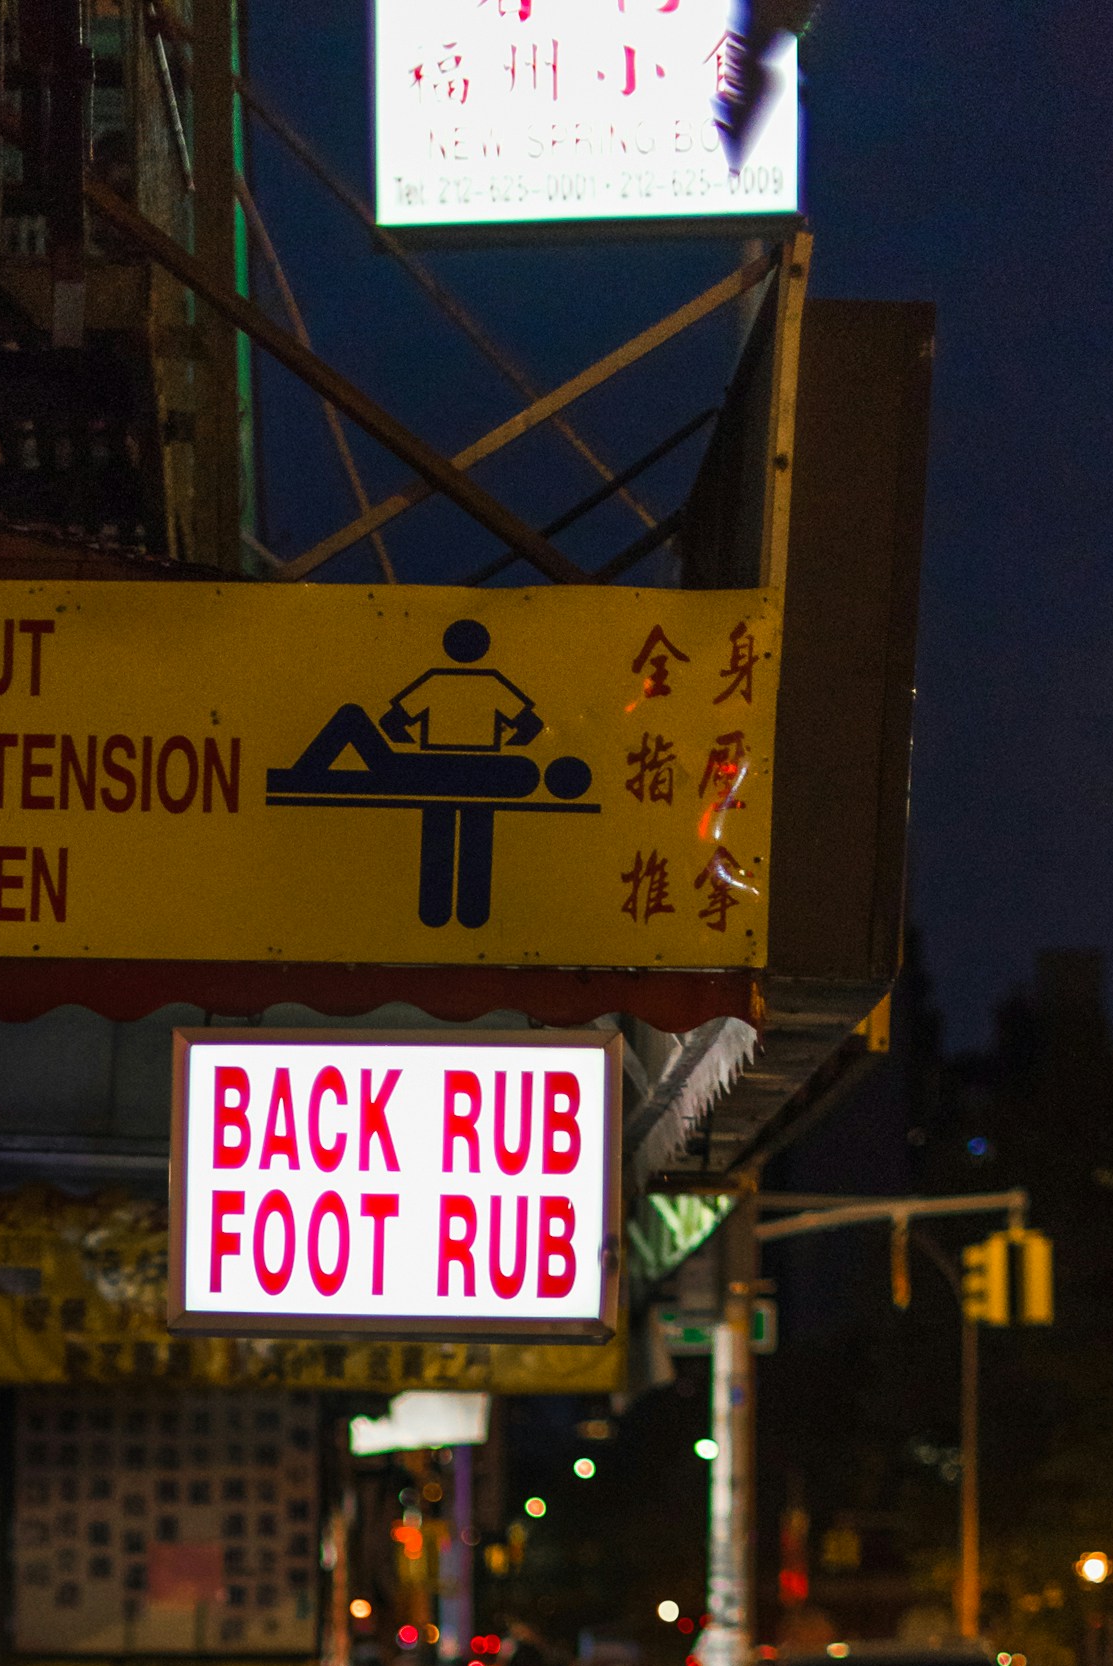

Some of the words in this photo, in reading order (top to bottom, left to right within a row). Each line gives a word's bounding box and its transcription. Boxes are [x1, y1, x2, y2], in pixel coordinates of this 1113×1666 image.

[427, 124, 505, 161] NEW
[528, 119, 656, 160] SPRING
[631, 621, 758, 705] 全身
[212, 1065, 403, 1173] BACK
[441, 1070, 582, 1175] RUB
[209, 1189, 399, 1296] FOOT
[436, 1194, 577, 1300] RUB
